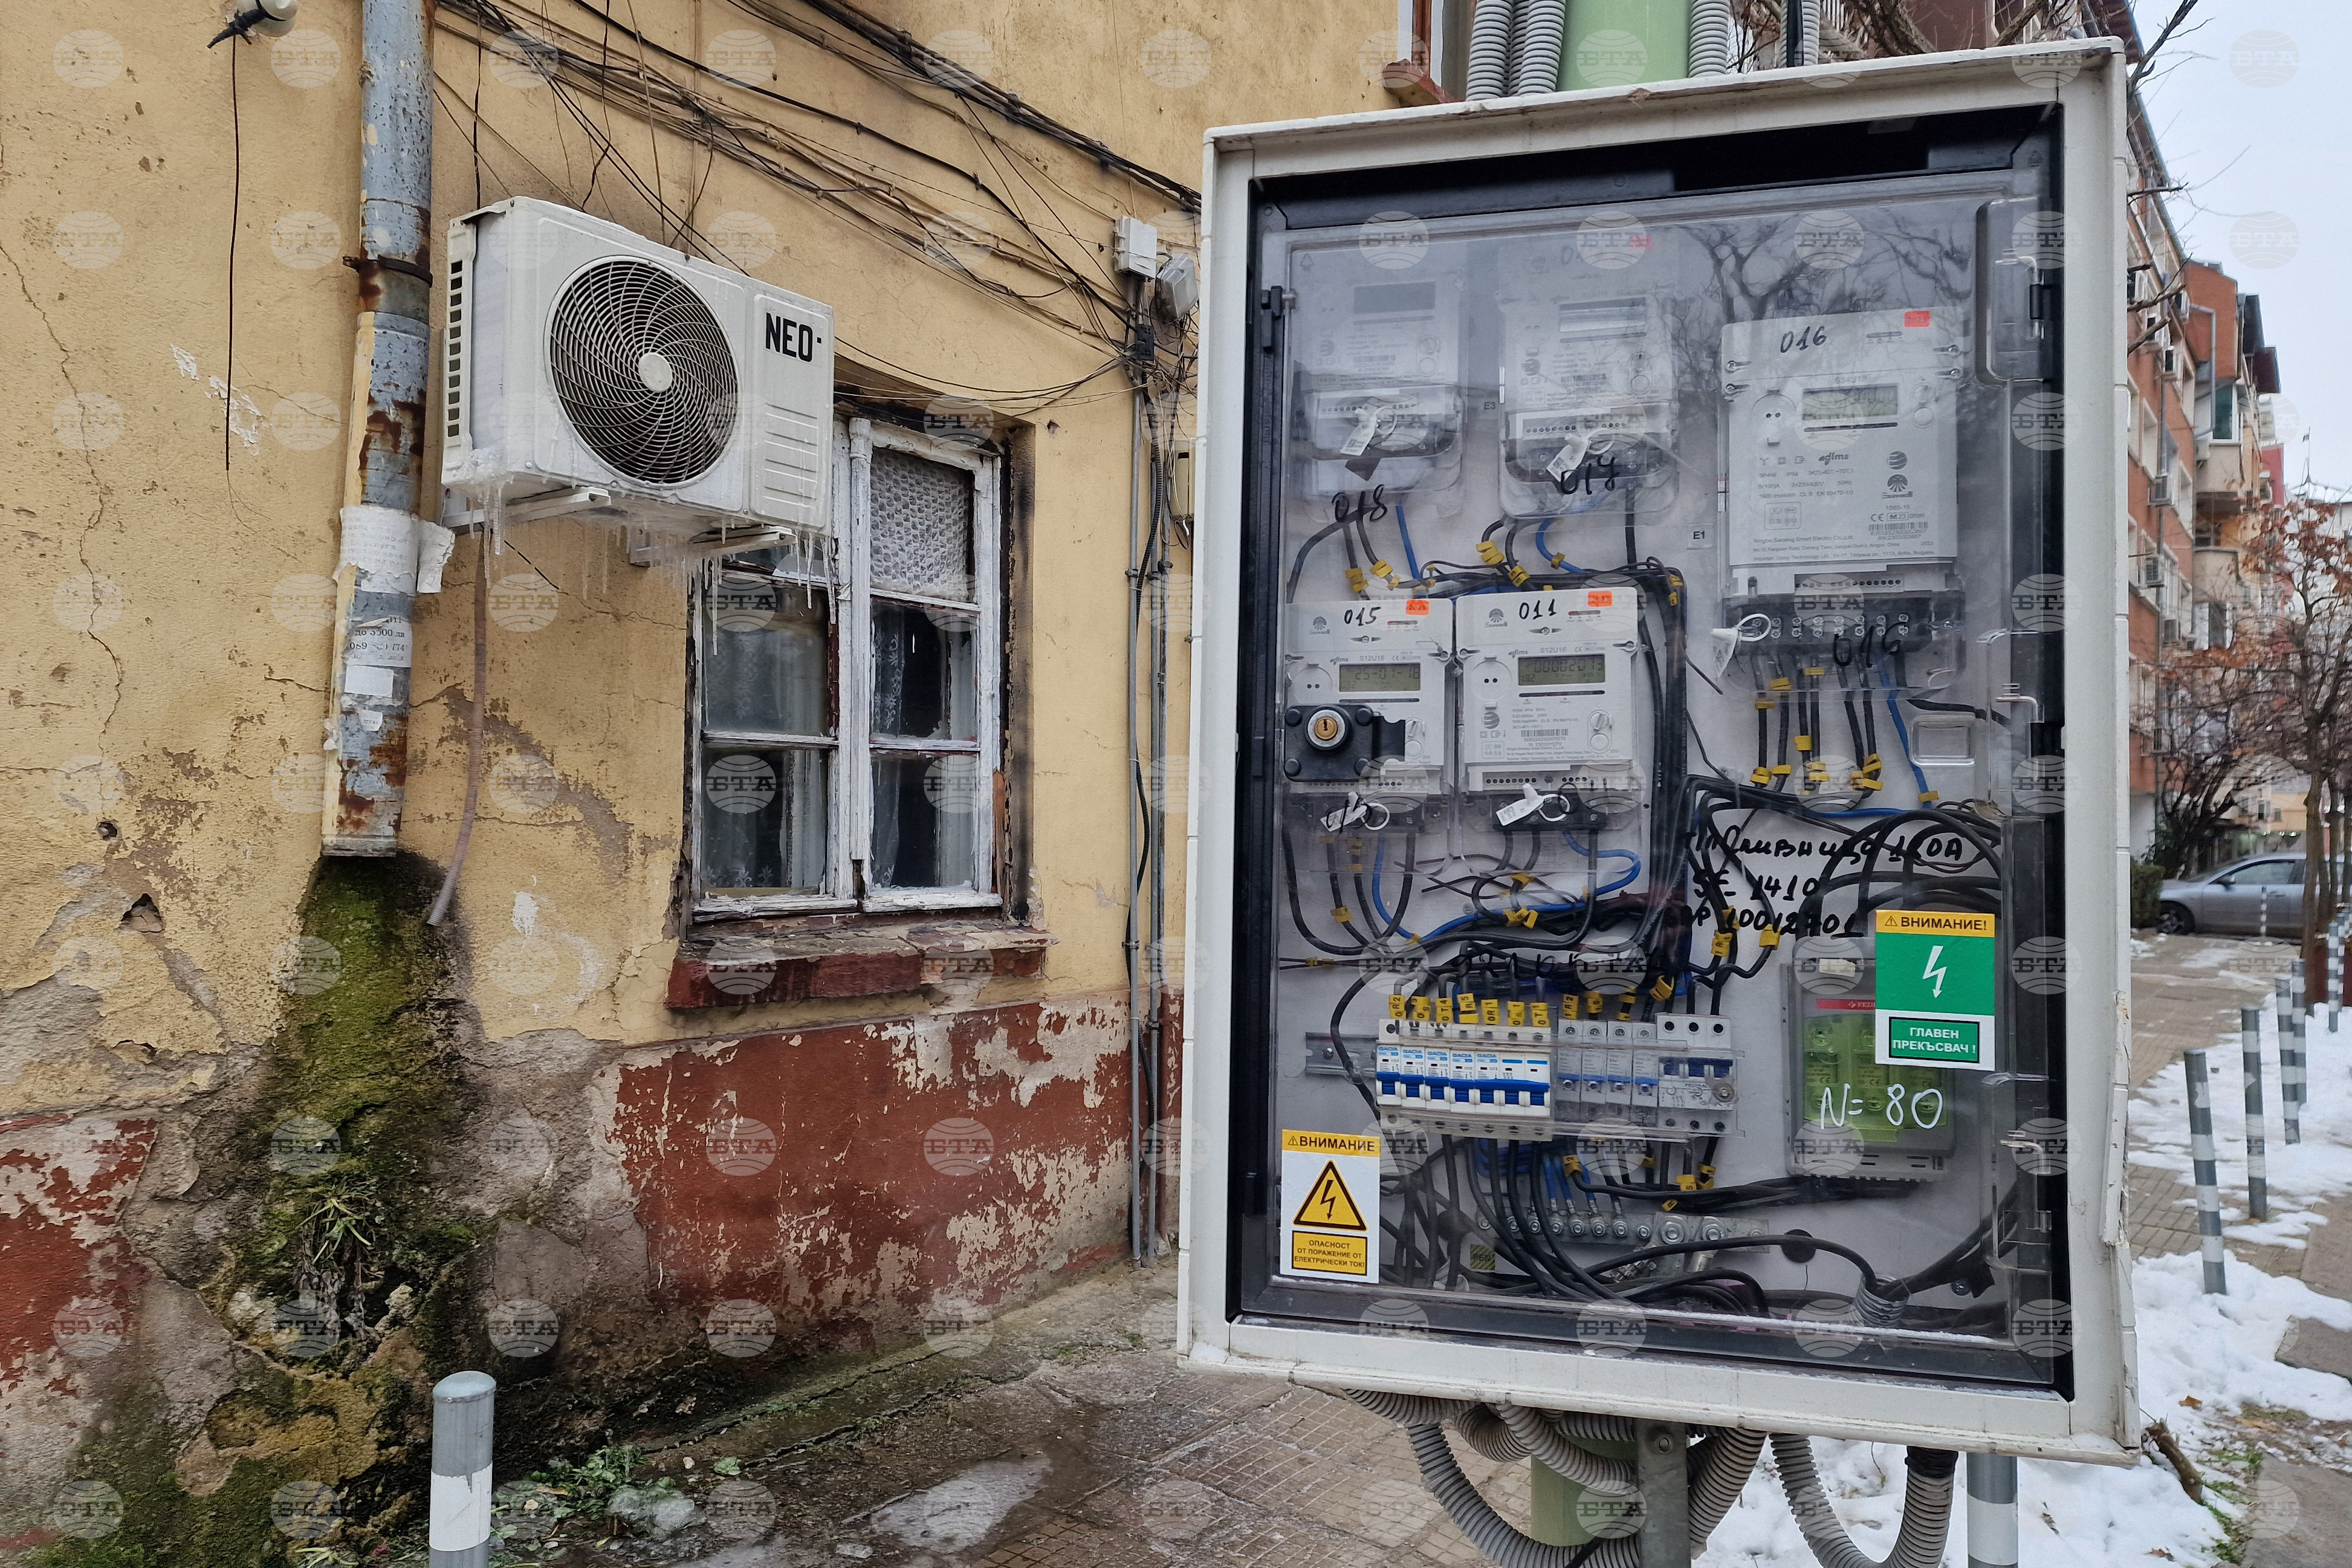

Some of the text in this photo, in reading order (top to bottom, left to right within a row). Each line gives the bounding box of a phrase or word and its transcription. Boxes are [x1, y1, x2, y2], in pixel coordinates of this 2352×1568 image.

[765, 311, 813, 363] NEO
[1780, 326, 1827, 353] 016
[1332, 484, 1388, 523] 018
[1693, 530, 1706, 539] E1
[1344, 606, 1381, 626] 015
[1519, 599, 1557, 620] 011
[1900, 916, 1988, 931] ВНИМАНИЕ!
[1910, 1026, 1960, 1040] ГЛАВЕН
[1893, 1039, 1969, 1054] ПРЕКЪСВАЧ
[1300, 1136, 1376, 1152] ВНИМАНИЕ
[1309, 1239, 1351, 1250] ОПАСНОСТ
[1294, 1255, 1348, 1267] ЕЛЕКТРИЧЕСКИ
[1308, 1248, 1351, 1259] ПОРАЖЕНИЕ
